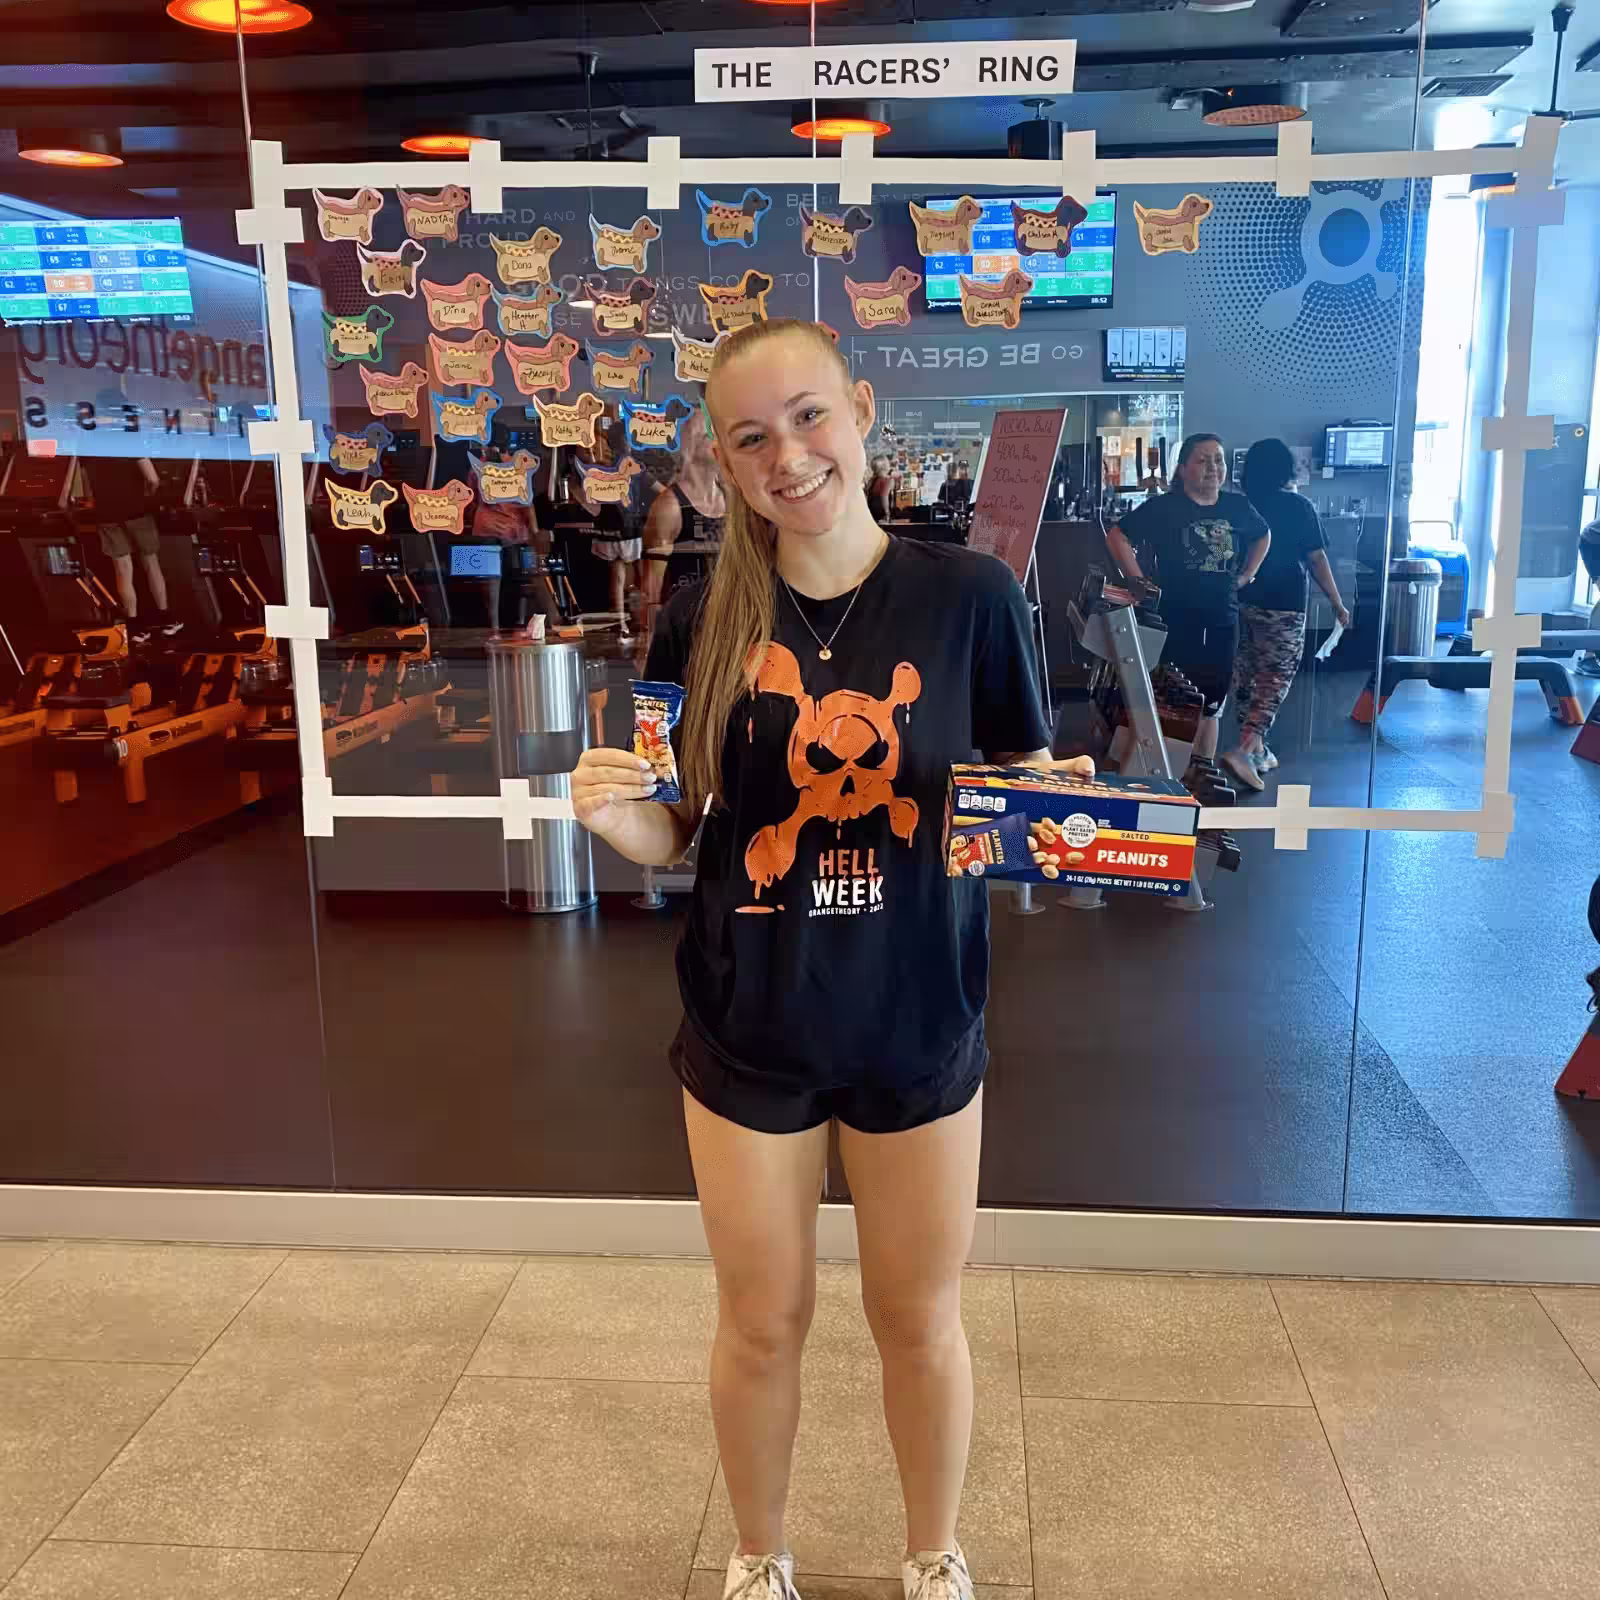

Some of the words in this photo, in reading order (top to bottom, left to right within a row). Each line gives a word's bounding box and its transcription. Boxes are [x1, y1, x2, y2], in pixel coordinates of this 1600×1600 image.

[711, 60, 773, 89] THE
[978, 55, 1060, 83] RING
[543, 210, 576, 222] AND
[784, 272, 811, 287] TO
[442, 304, 466, 316] Dina
[639, 426, 667, 438] Luke
[346, 507, 374, 518] Leah
[1120, 832, 1150, 841] SALTED
[991, 828, 1006, 865] PLANTERS
[819, 848, 880, 877] HELL
[1096, 849, 1169, 869] PEANUTS
[811, 875, 884, 907] WEEK
[808, 906, 861, 918] ORANGETHEORY
